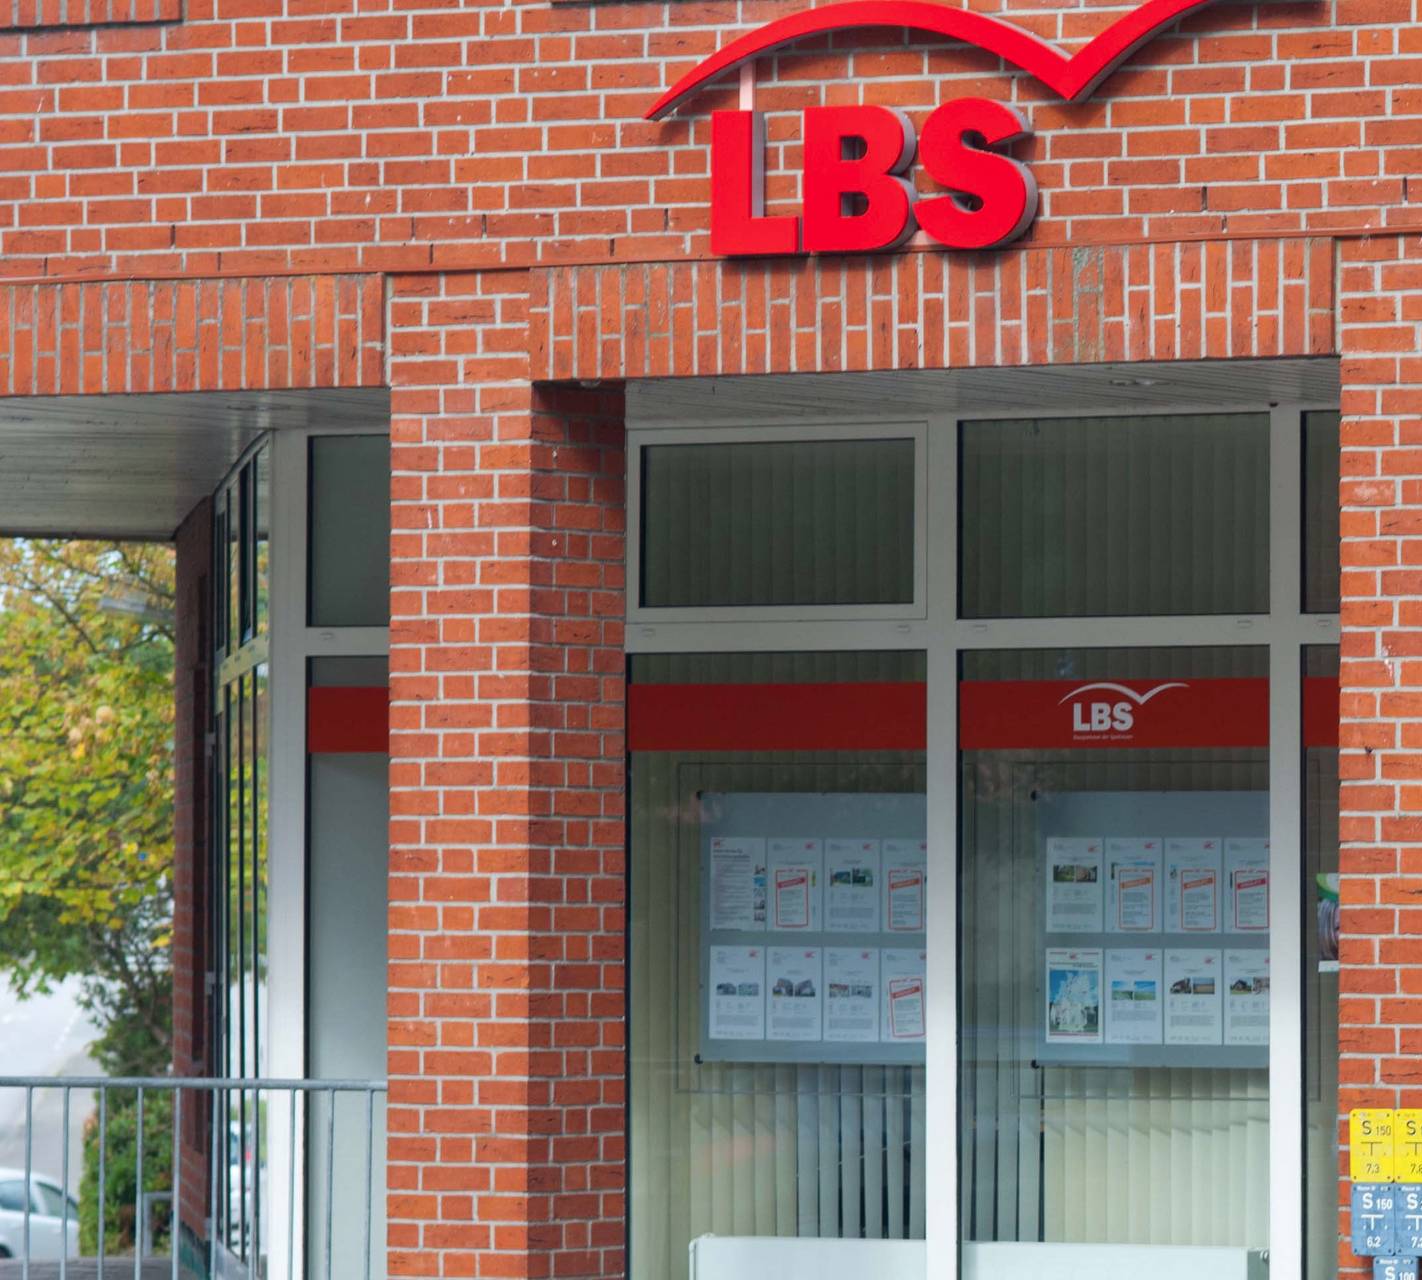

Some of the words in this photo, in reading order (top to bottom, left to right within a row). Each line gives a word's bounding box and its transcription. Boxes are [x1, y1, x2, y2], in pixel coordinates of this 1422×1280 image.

[711, 97, 1038, 256] LBS
[1073, 702, 1134, 732] LBS
[1362, 1120, 1372, 1136] S
[1375, 1126, 1392, 1136] 150
[1406, 1120, 1416, 1136] S
[1362, 1193, 1373, 1210] S
[1376, 1199, 1393, 1210] 150
[1406, 1194, 1418, 1210] S
